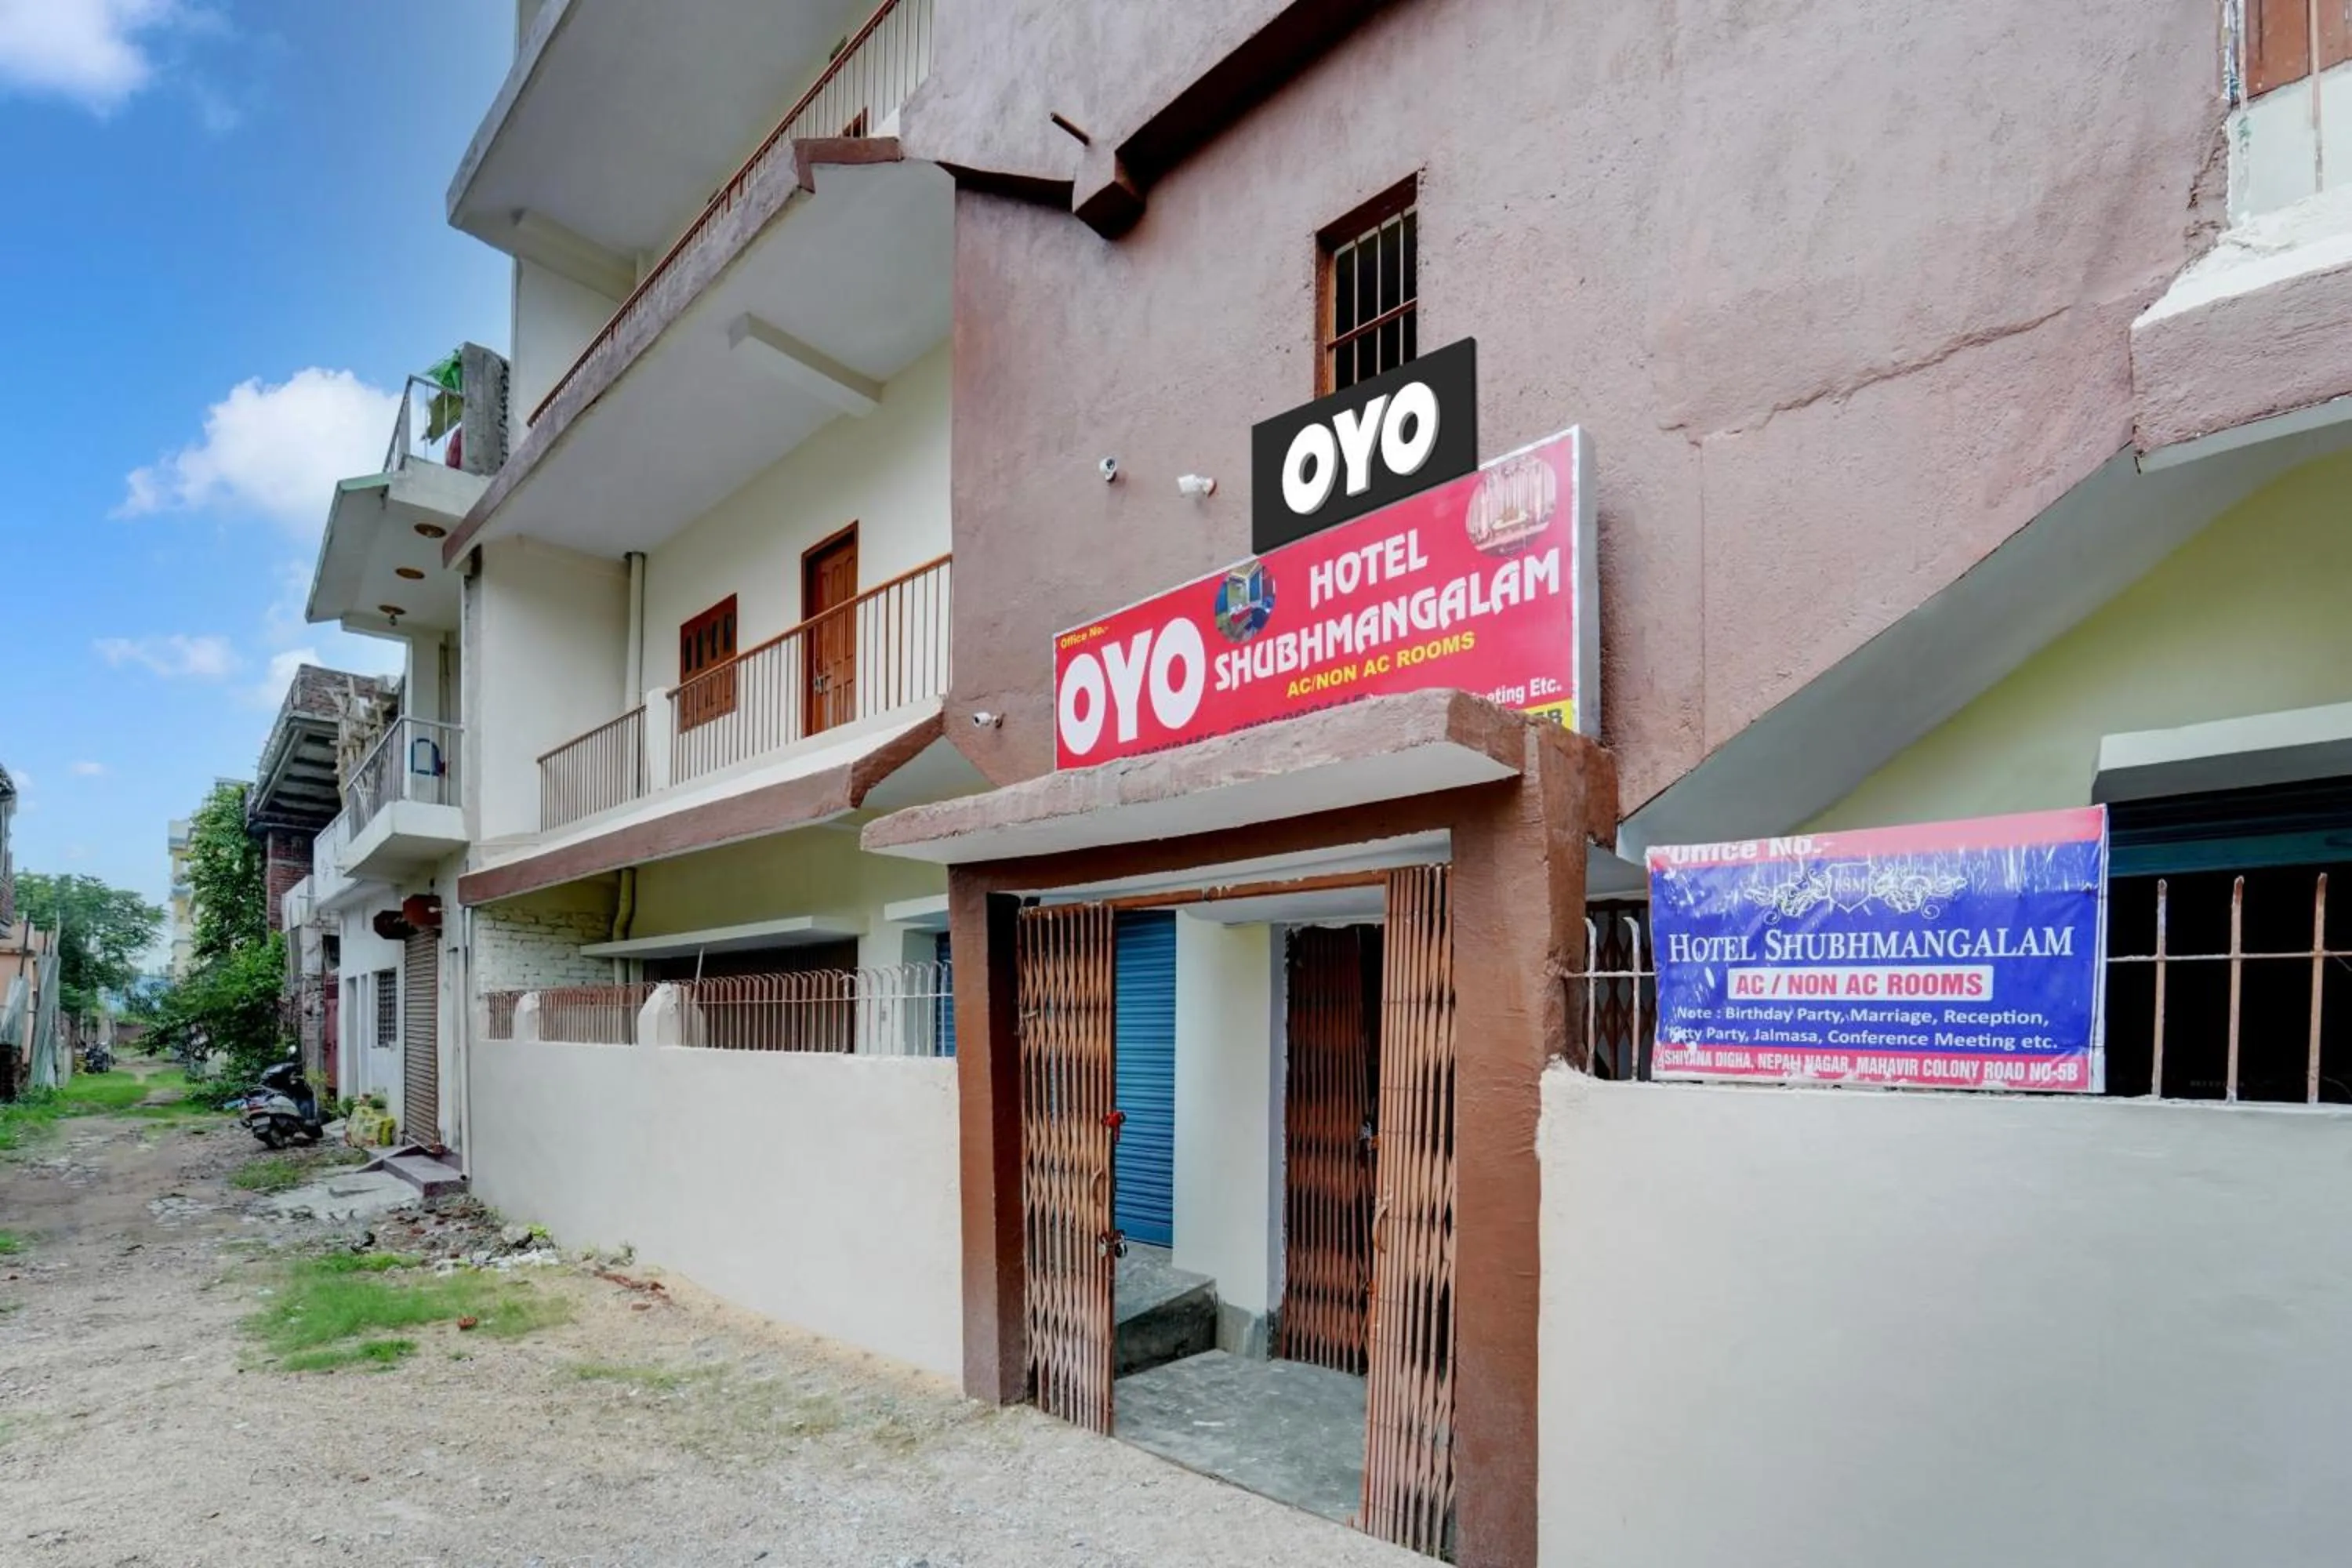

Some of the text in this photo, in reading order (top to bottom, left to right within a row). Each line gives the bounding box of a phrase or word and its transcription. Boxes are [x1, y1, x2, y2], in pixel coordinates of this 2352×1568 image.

[1281, 381, 1440, 515] OYO
[1310, 528, 1428, 609] HOTEL
[1214, 547, 1560, 691] SHUBHMANGALAM
[1058, 617, 1206, 756] OYO
[1286, 631, 1475, 699] AC/NON AC ROOMS
[1530, 677, 1563, 698] Etc.
[1735, 975, 1765, 995] AC
[1787, 975, 1838, 996] NON
[1845, 975, 1878, 996] AC
[1886, 973, 1984, 996] ROOMS
[1676, 1006, 1713, 1019] Note
[1726, 1007, 1793, 1022] Birthday
[1797, 1009, 1845, 1024] Party,
[1850, 1008, 1937, 1025] Marriage,
[1944, 1009, 2050, 1028] Reception,
[1707, 1026, 1749, 1043] Party,
[1753, 1029, 1823, 1044] Jalmasa,
[1828, 1029, 1929, 1046] Conference
[1934, 1033, 2015, 1051] Meeting
[2021, 1034, 2058, 1049] etc.
[1856, 1056, 1918, 1077] MAHAVIR
[1922, 1058, 1980, 1079] COLONY
[1984, 1061, 2025, 1081] ROAD
